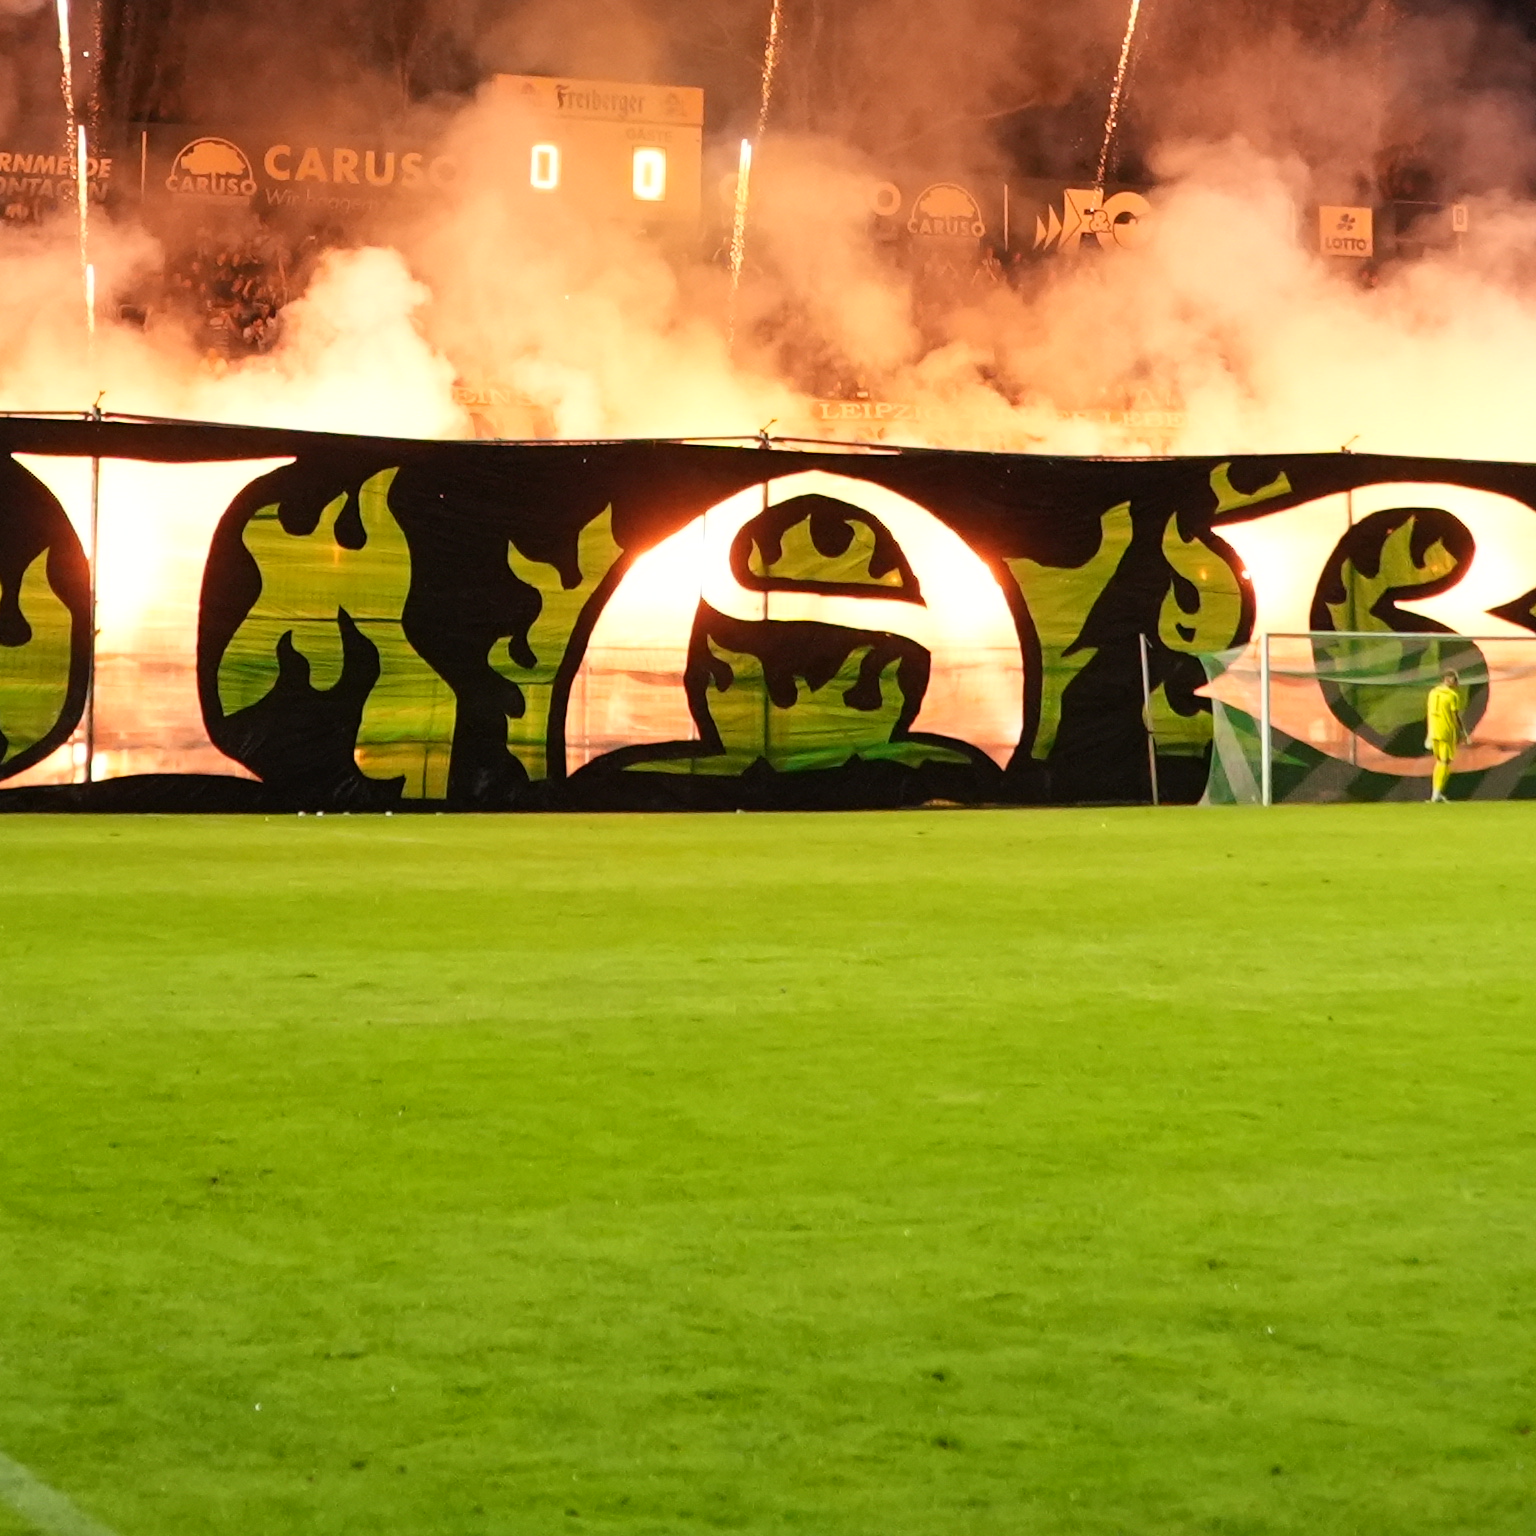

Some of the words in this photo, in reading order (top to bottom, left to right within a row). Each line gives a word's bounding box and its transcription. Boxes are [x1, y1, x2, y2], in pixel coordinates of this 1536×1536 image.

[553, 84, 645, 121] Freiberger
[263, 144, 458, 190] CARUSO
[530, 145, 558, 189] 0
[633, 148, 665, 200] 0
[165, 174, 258, 196] CARUSO
[265, 188, 300, 207] Wir
[907, 217, 986, 238] CARUSO
[1325, 237, 1367, 251] LOTTO
